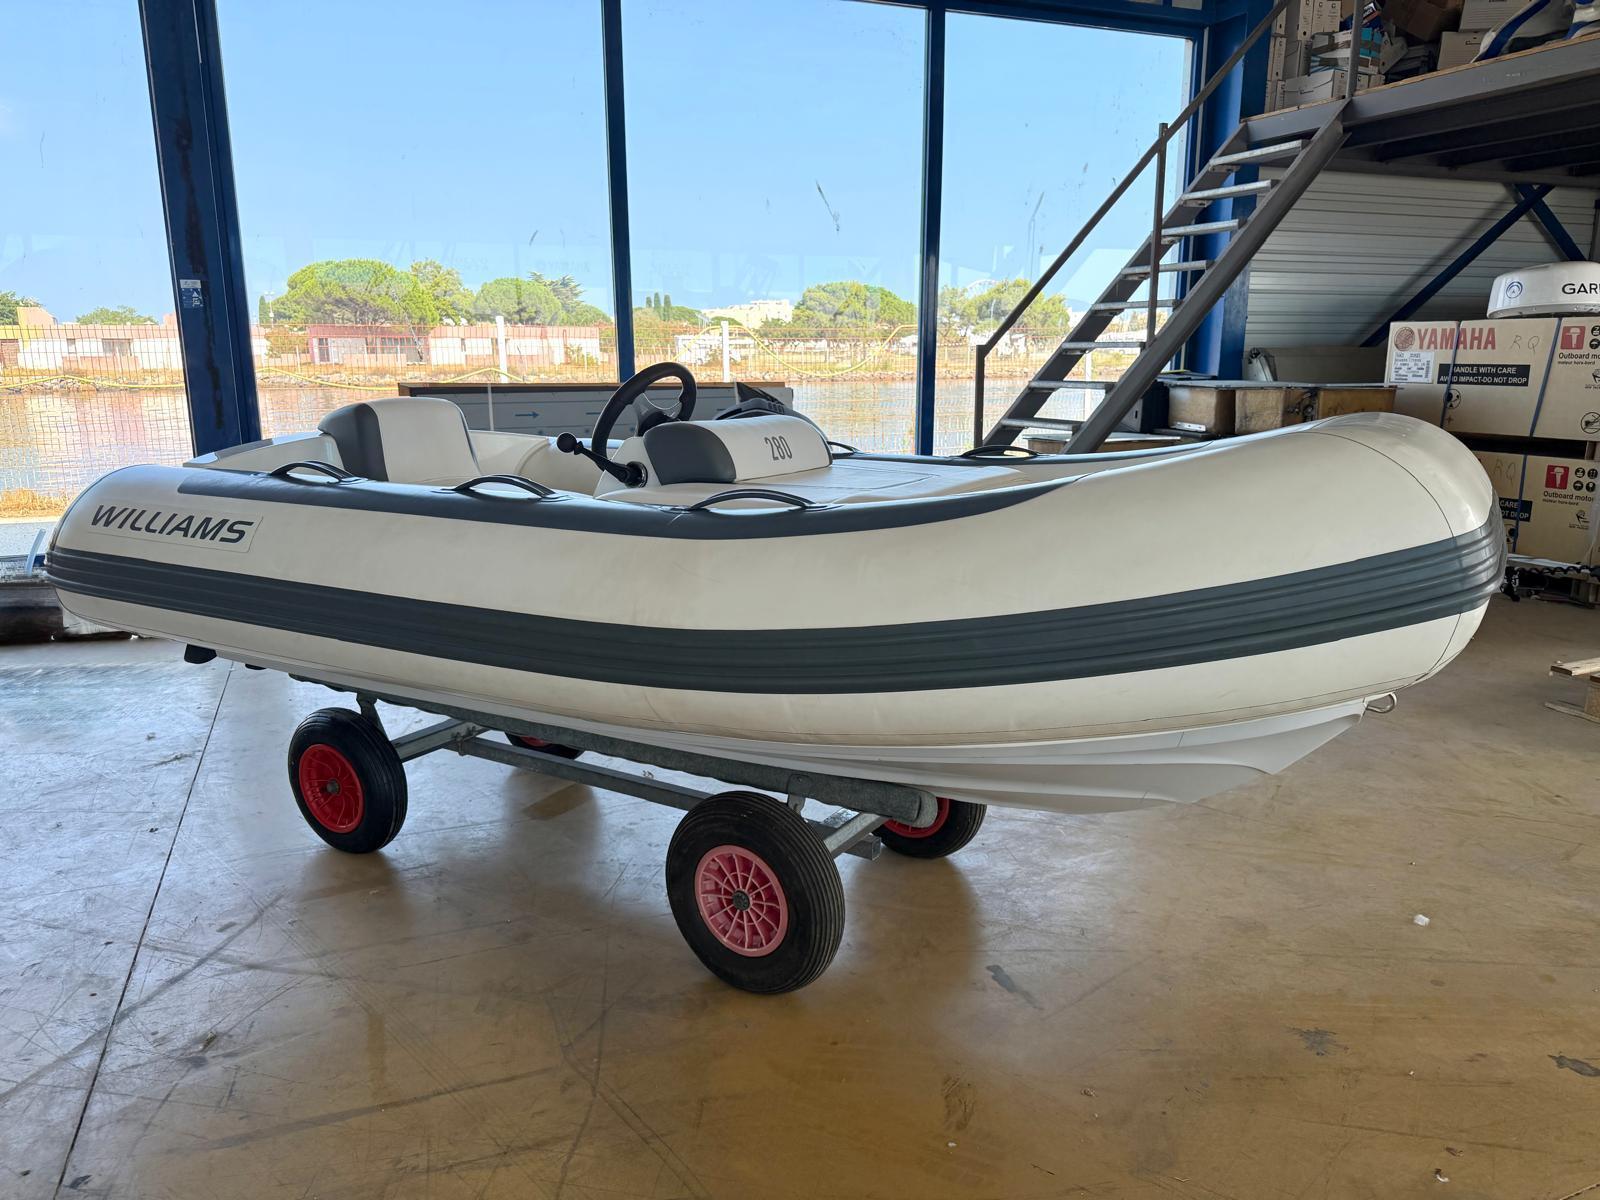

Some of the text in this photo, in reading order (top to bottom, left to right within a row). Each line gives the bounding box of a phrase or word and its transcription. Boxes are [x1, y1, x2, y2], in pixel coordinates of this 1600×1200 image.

[1561, 283, 1600, 295] GAR
[1417, 327, 1496, 350] YAMAHA
[1558, 352, 1590, 360] Outboard
[1479, 366, 1496, 374] WITH
[1440, 375, 1458, 383] AVID
[764, 435, 792, 460] 280
[1543, 490, 1574, 500] Outboard
[1500, 500, 1519, 509] CARE
[91, 504, 254, 543] WILLIAMS
